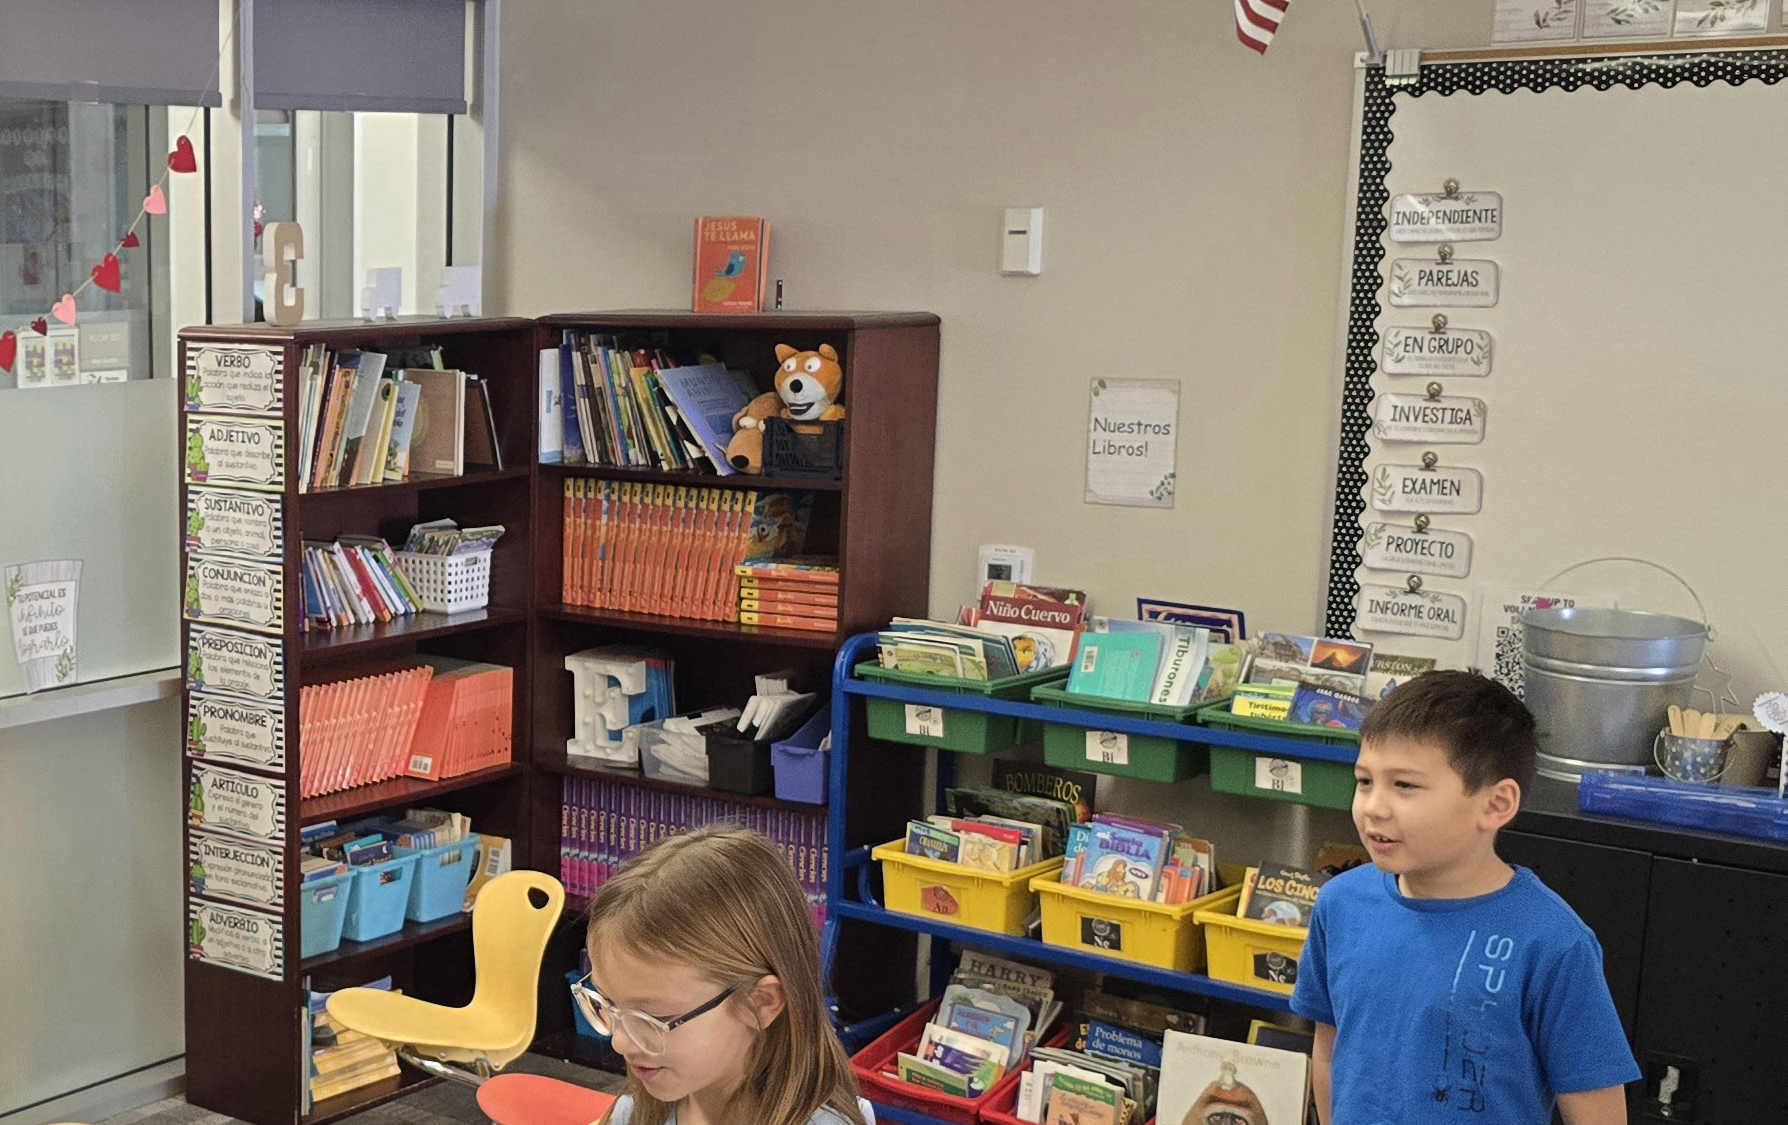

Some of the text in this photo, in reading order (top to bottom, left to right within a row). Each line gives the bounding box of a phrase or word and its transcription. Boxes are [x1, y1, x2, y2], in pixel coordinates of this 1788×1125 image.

[1393, 207, 1498, 226] INDEPENDIENTE
[719, 230, 757, 241] LLAMA
[1417, 269, 1480, 288] PAREJAS
[1403, 336, 1475, 356] EN GRUPO
[215, 355, 251, 369] VERBO
[1093, 416, 1172, 436] Nuestros
[1390, 405, 1473, 426] INVESTIGA
[208, 428, 261, 445] ADJETIVO
[1092, 438, 1149, 458] Libros!
[1401, 477, 1461, 497] EXAMEN
[203, 498, 265, 517] SUSTANTIVO
[1385, 535, 1455, 559] PROYECTO
[985, 600, 1071, 624] Niño Cuervo
[1367, 599, 1424, 620] INFORME
[1427, 607, 1457, 625] ORAL
[1563, 599, 1575, 609] TO
[1158, 635, 1191, 704] Tiburones
[203, 704, 268, 728] PRONOMBRE
[1005, 773, 1082, 804] BOMBEROS
[1098, 838, 1152, 861] BIBLIA
[1257, 875, 1319, 900] LOS CINC
[209, 912, 260, 934] ADVERBIO
[969, 958, 1043, 987] HARRY
[1093, 1026, 1144, 1049] Problema
[1091, 1038, 1143, 1061] de monos
[1176, 1040, 1282, 1072] Anthony Browne
